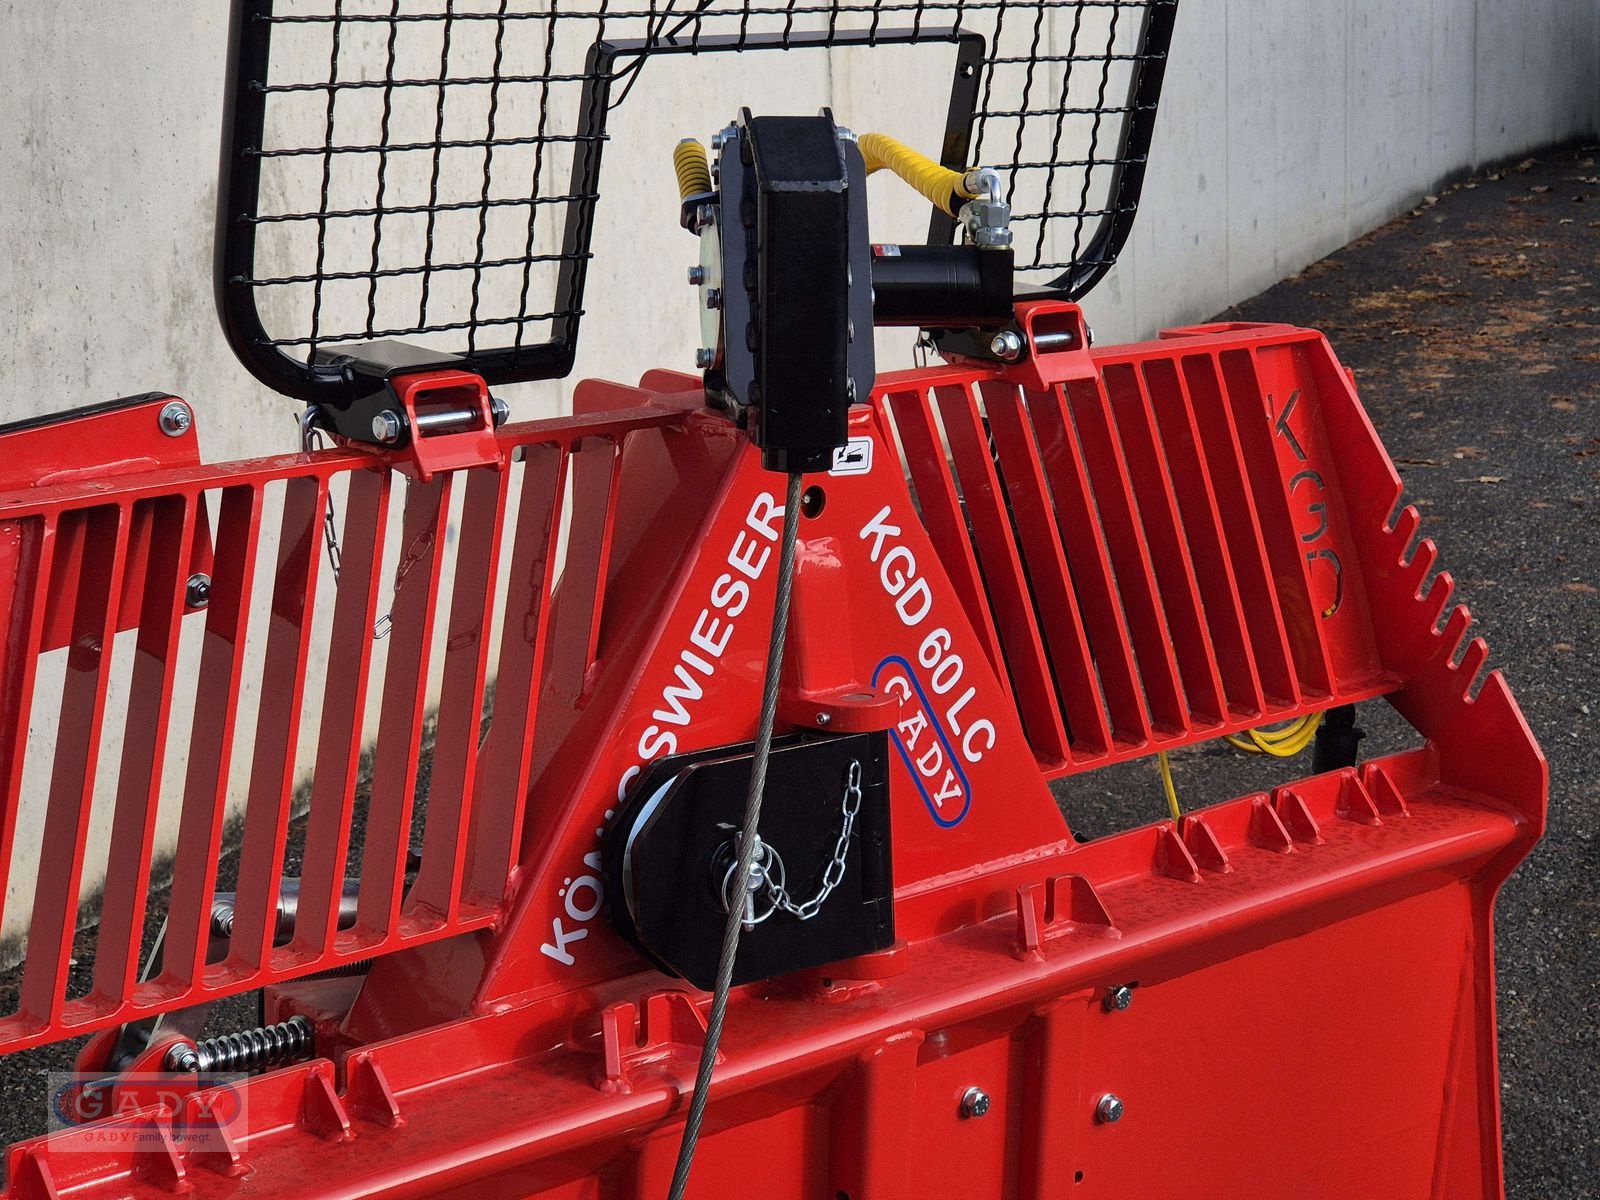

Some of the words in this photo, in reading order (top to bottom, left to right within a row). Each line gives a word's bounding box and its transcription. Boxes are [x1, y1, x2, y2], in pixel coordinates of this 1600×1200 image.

[540, 491, 785, 966] KÖSWIESER
[859, 505, 933, 626] KGD
[918, 627, 964, 695] 60
[946, 686, 996, 763] LC
